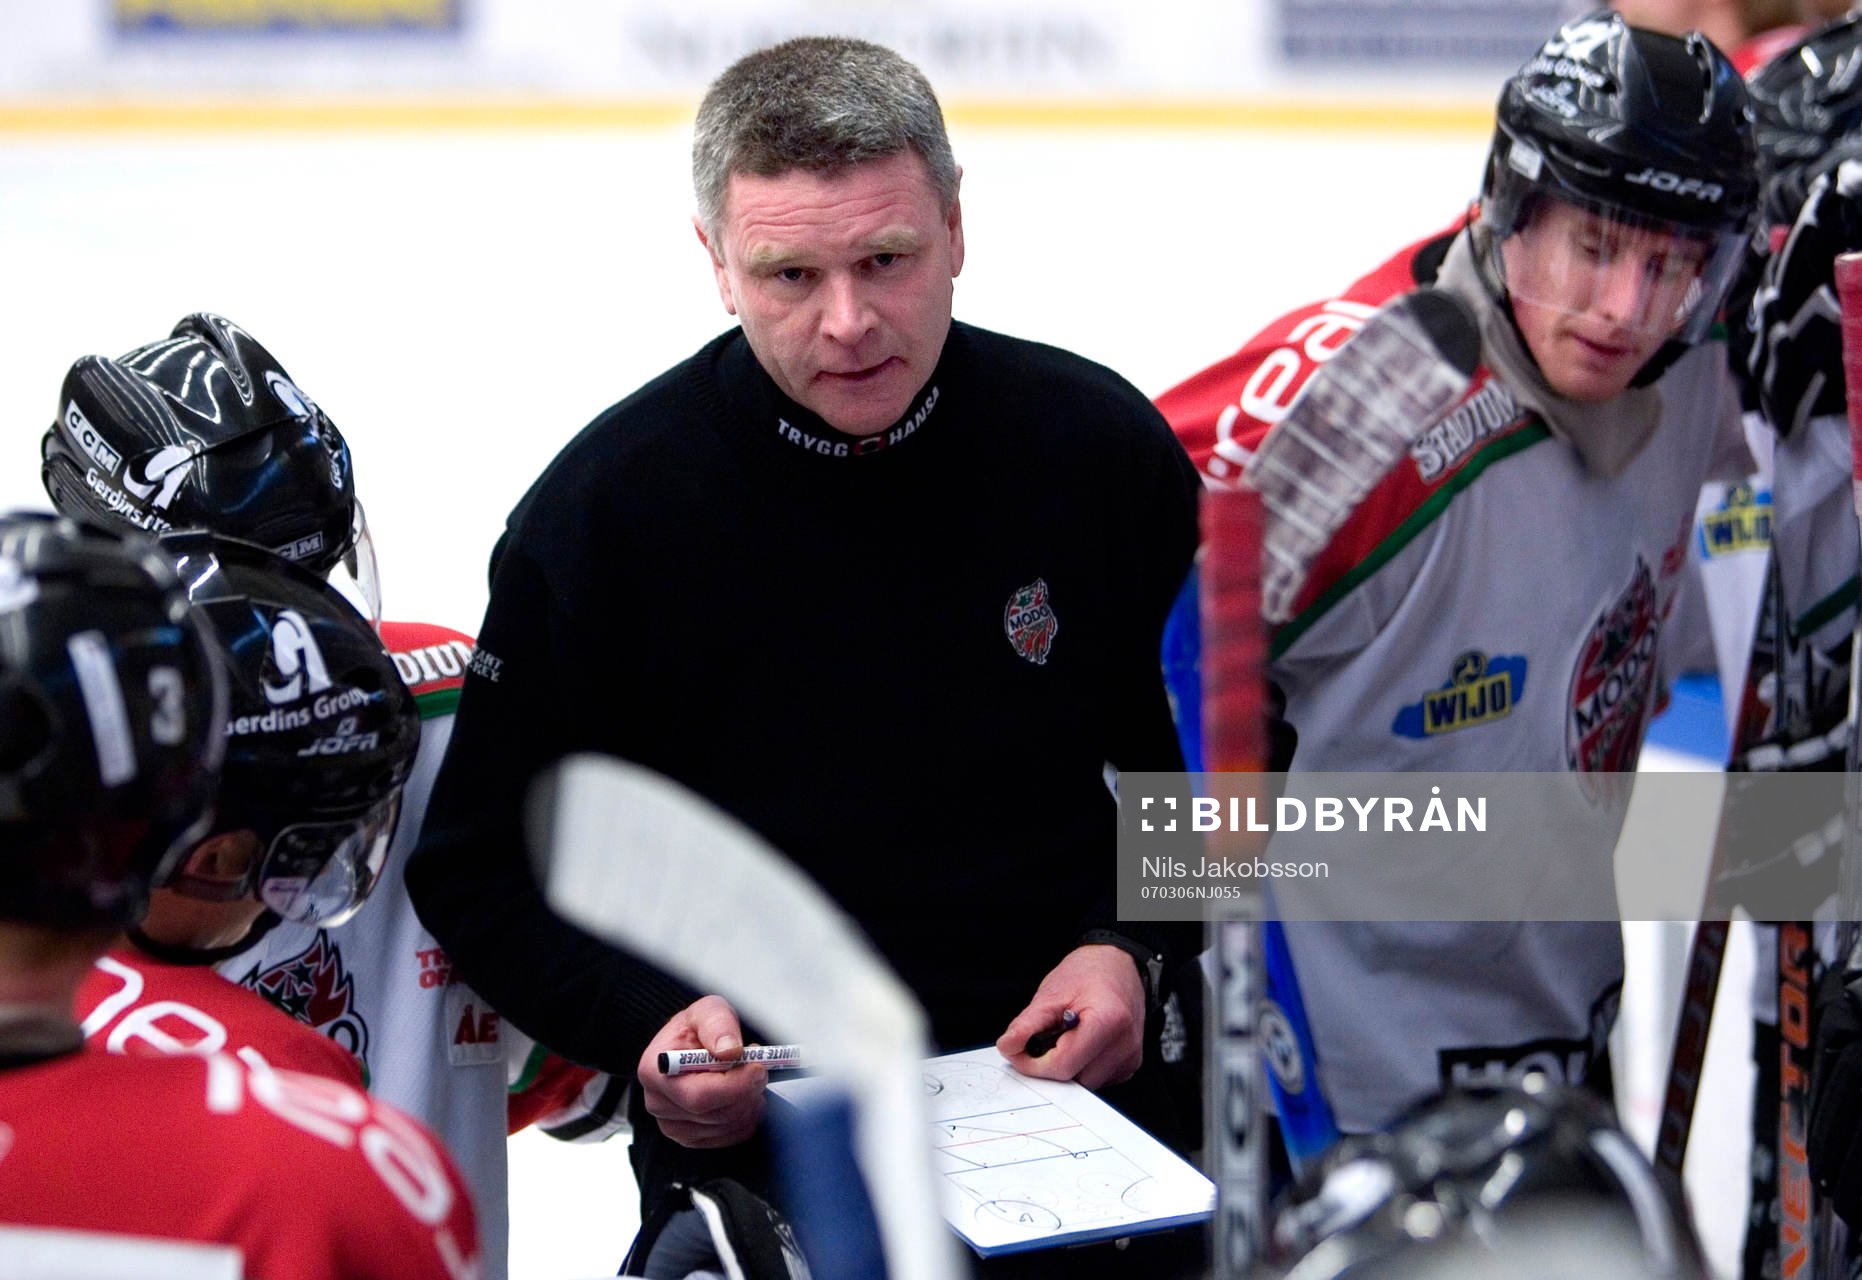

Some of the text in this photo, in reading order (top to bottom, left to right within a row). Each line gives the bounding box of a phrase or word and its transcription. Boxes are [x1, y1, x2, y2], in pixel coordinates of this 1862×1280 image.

[1625, 168, 1723, 203] JOFA
[68, 410, 119, 474] CCM
[778, 386, 939, 457] TRYGG HANSA
[86, 467, 143, 523] Gerdins
[1009, 605, 1049, 630] MODO
[1428, 679, 1507, 728] WIJO
[1573, 623, 1658, 738] MODO
[298, 732, 379, 757] JOFA
